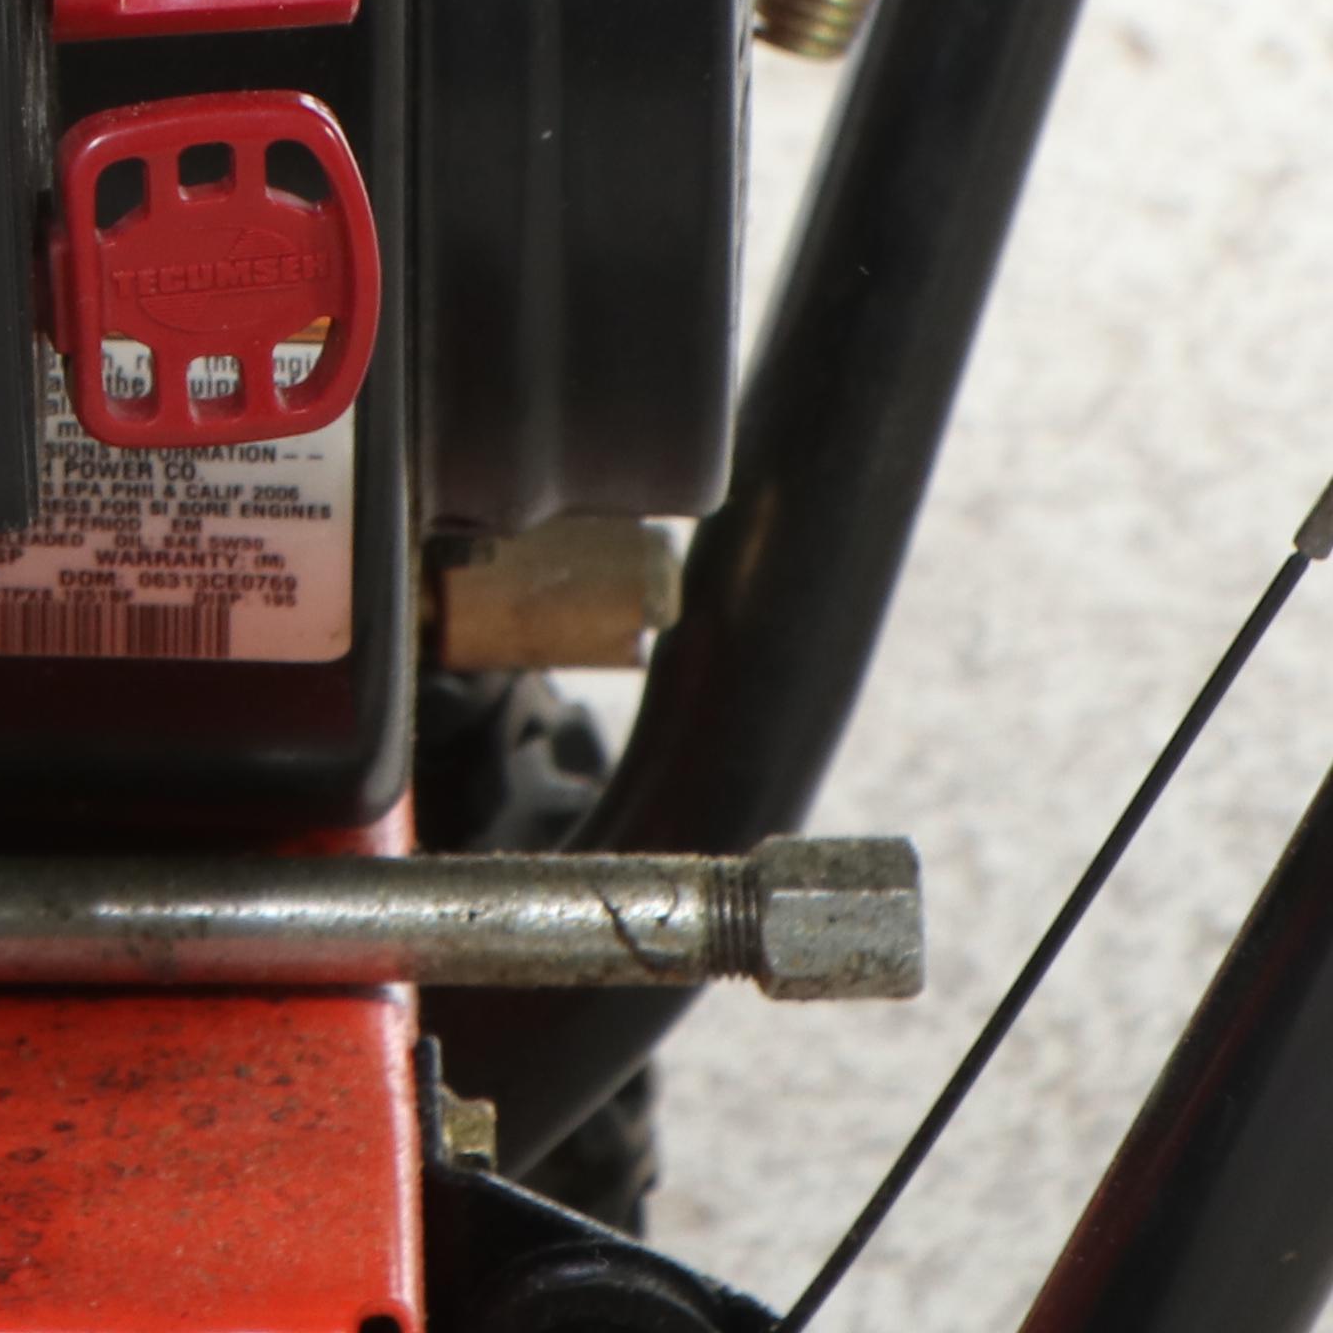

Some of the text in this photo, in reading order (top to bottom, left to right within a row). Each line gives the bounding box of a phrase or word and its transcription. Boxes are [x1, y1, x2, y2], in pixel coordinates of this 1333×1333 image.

[112, 253, 328, 297] TECUMSEH
[120, 444, 276, 463] INFORMATION
[64, 461, 154, 480] POWER
[63, 484, 102, 497] EPA
[163, 485, 176, 499] &
[185, 486, 244, 500] CALIF
[253, 486, 300, 501] 2006
[100, 500, 141, 514] FOR
[240, 503, 331, 519] ENGINES
[64, 517, 141, 532] PERIOD
[172, 519, 203, 532] EM
[164, 535, 199, 550] SAE
